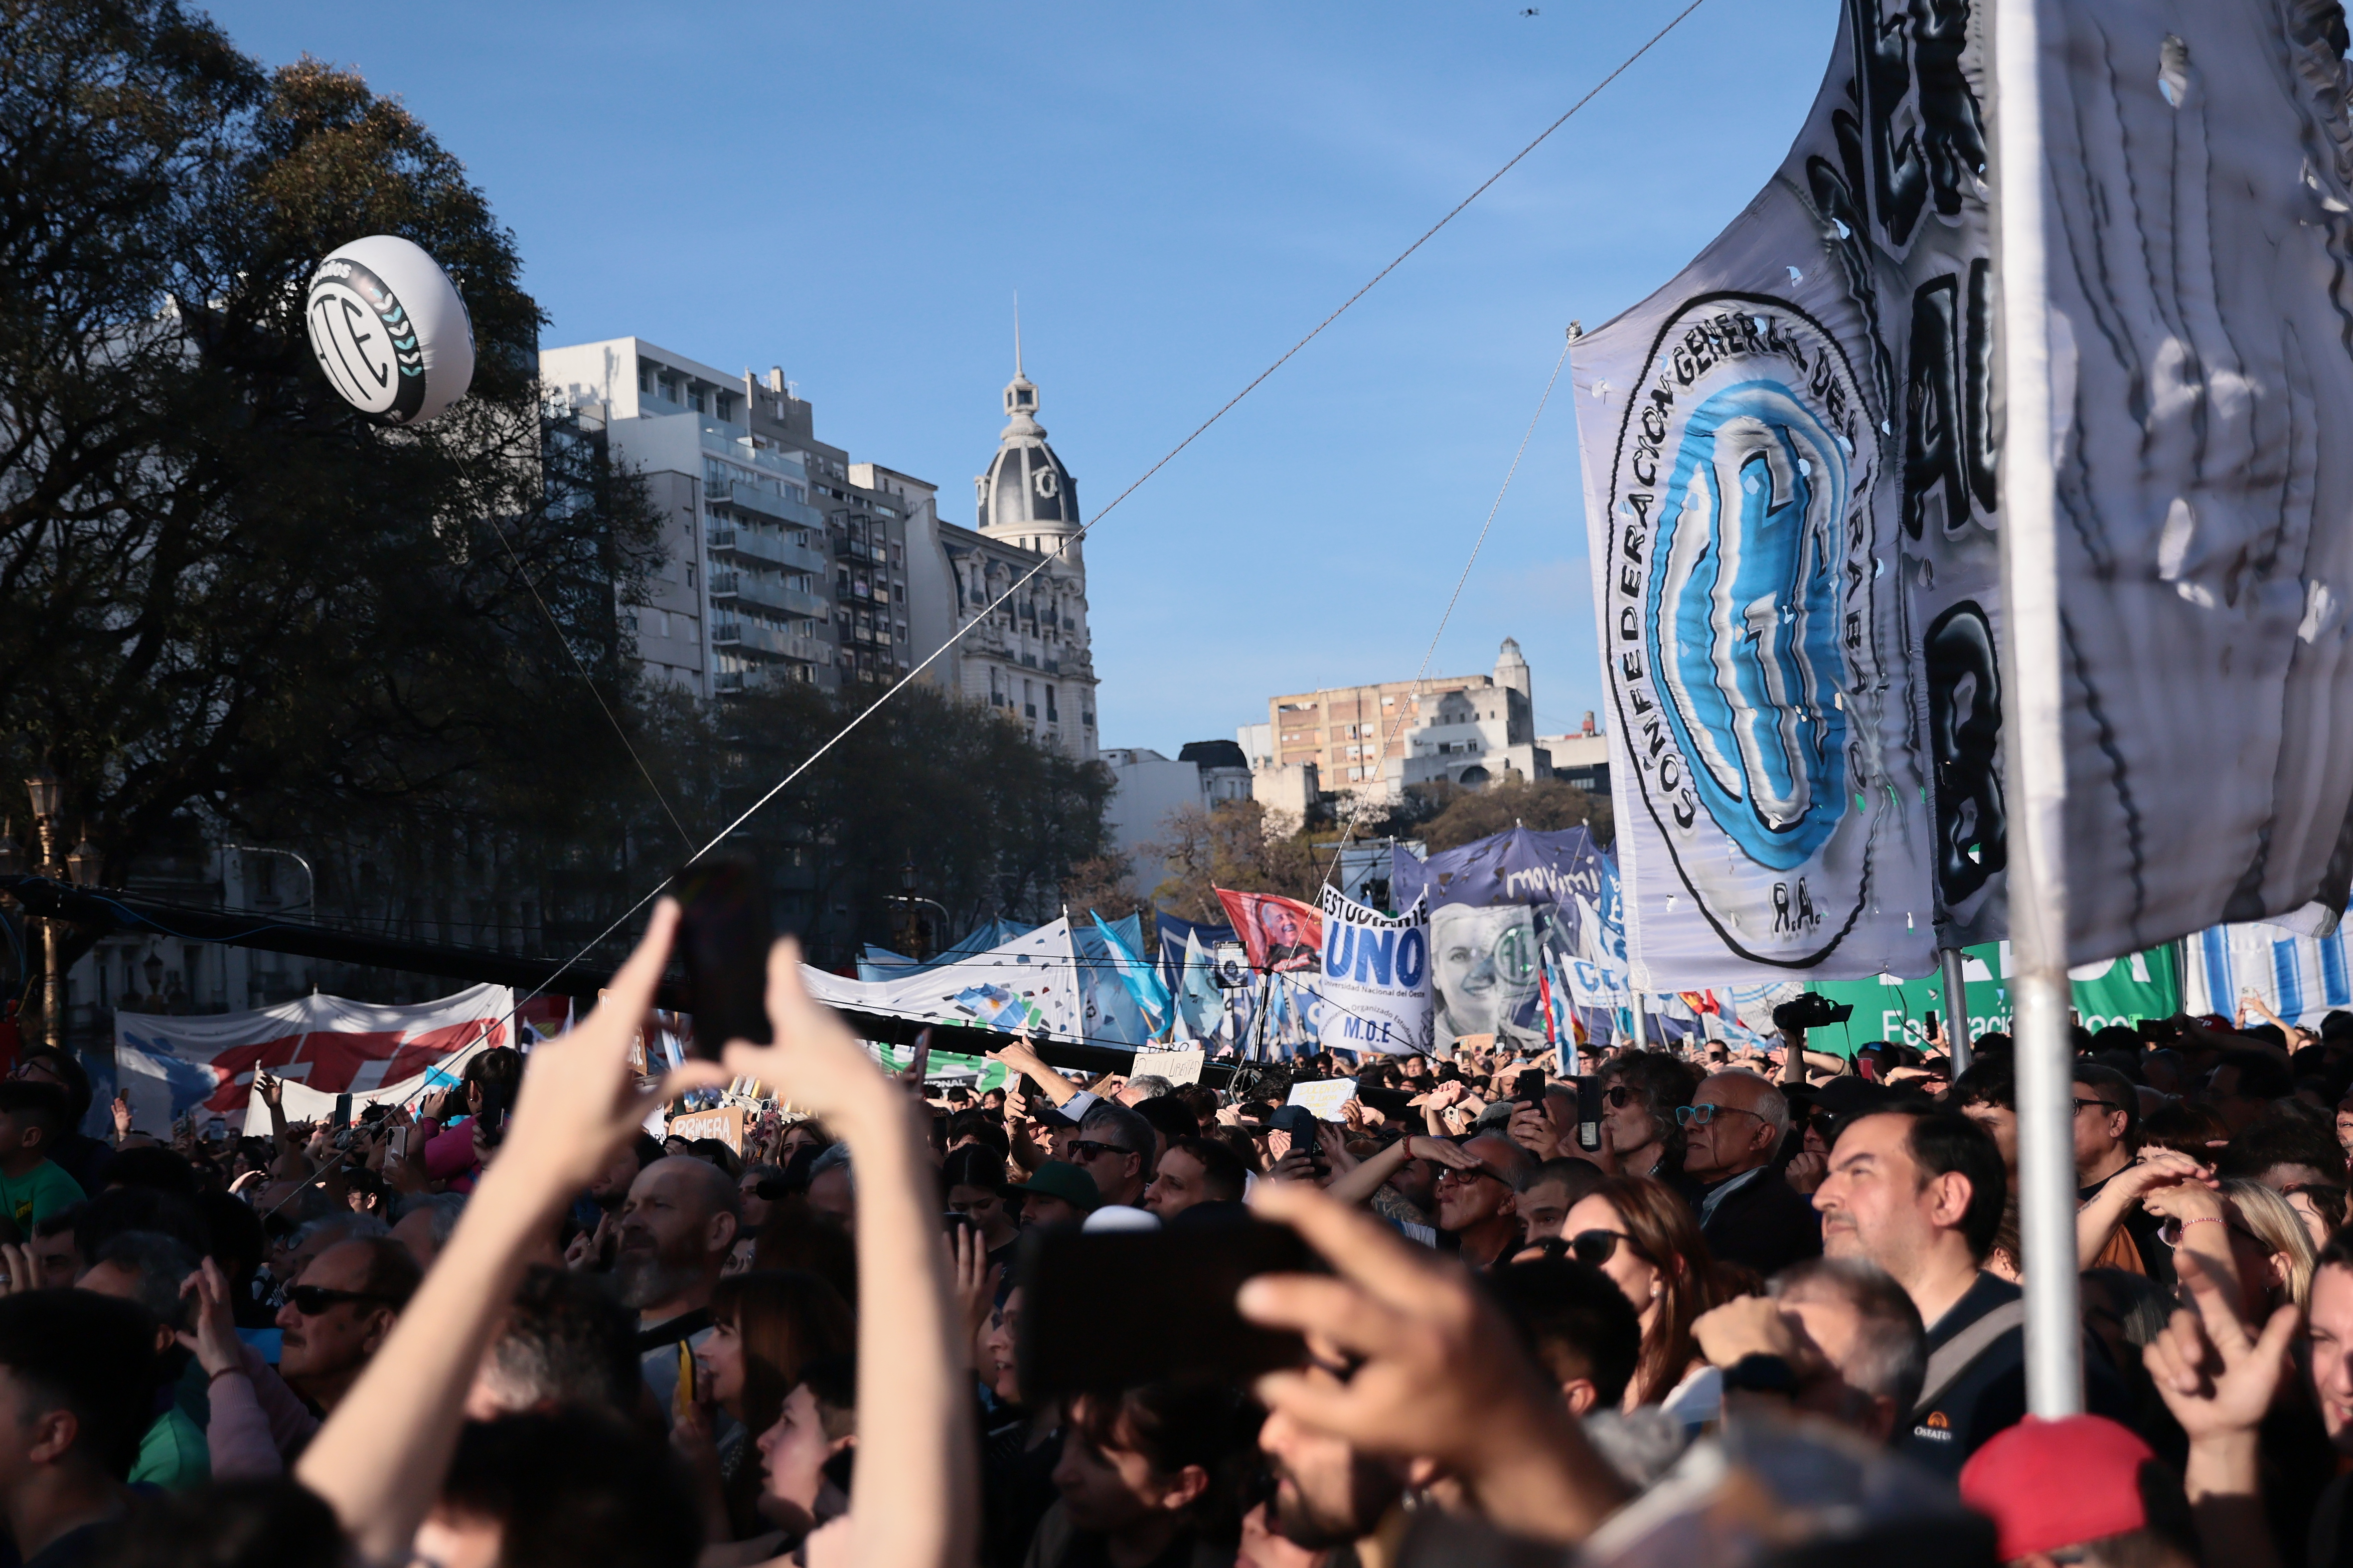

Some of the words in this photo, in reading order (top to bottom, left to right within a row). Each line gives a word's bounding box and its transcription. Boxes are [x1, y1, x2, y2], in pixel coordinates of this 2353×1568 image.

[1845, 458, 1871, 788] TRABAO
[1507, 855, 1604, 899] movimi
[1773, 877, 1820, 933] R.A.
[1326, 921, 1425, 987] UNO
[1324, 979, 1359, 991] Universidad
[1362, 986, 1394, 996] Nacional
[1344, 1016, 1391, 1043] M.O.E
[1351, 1004, 1393, 1018] Organizado
